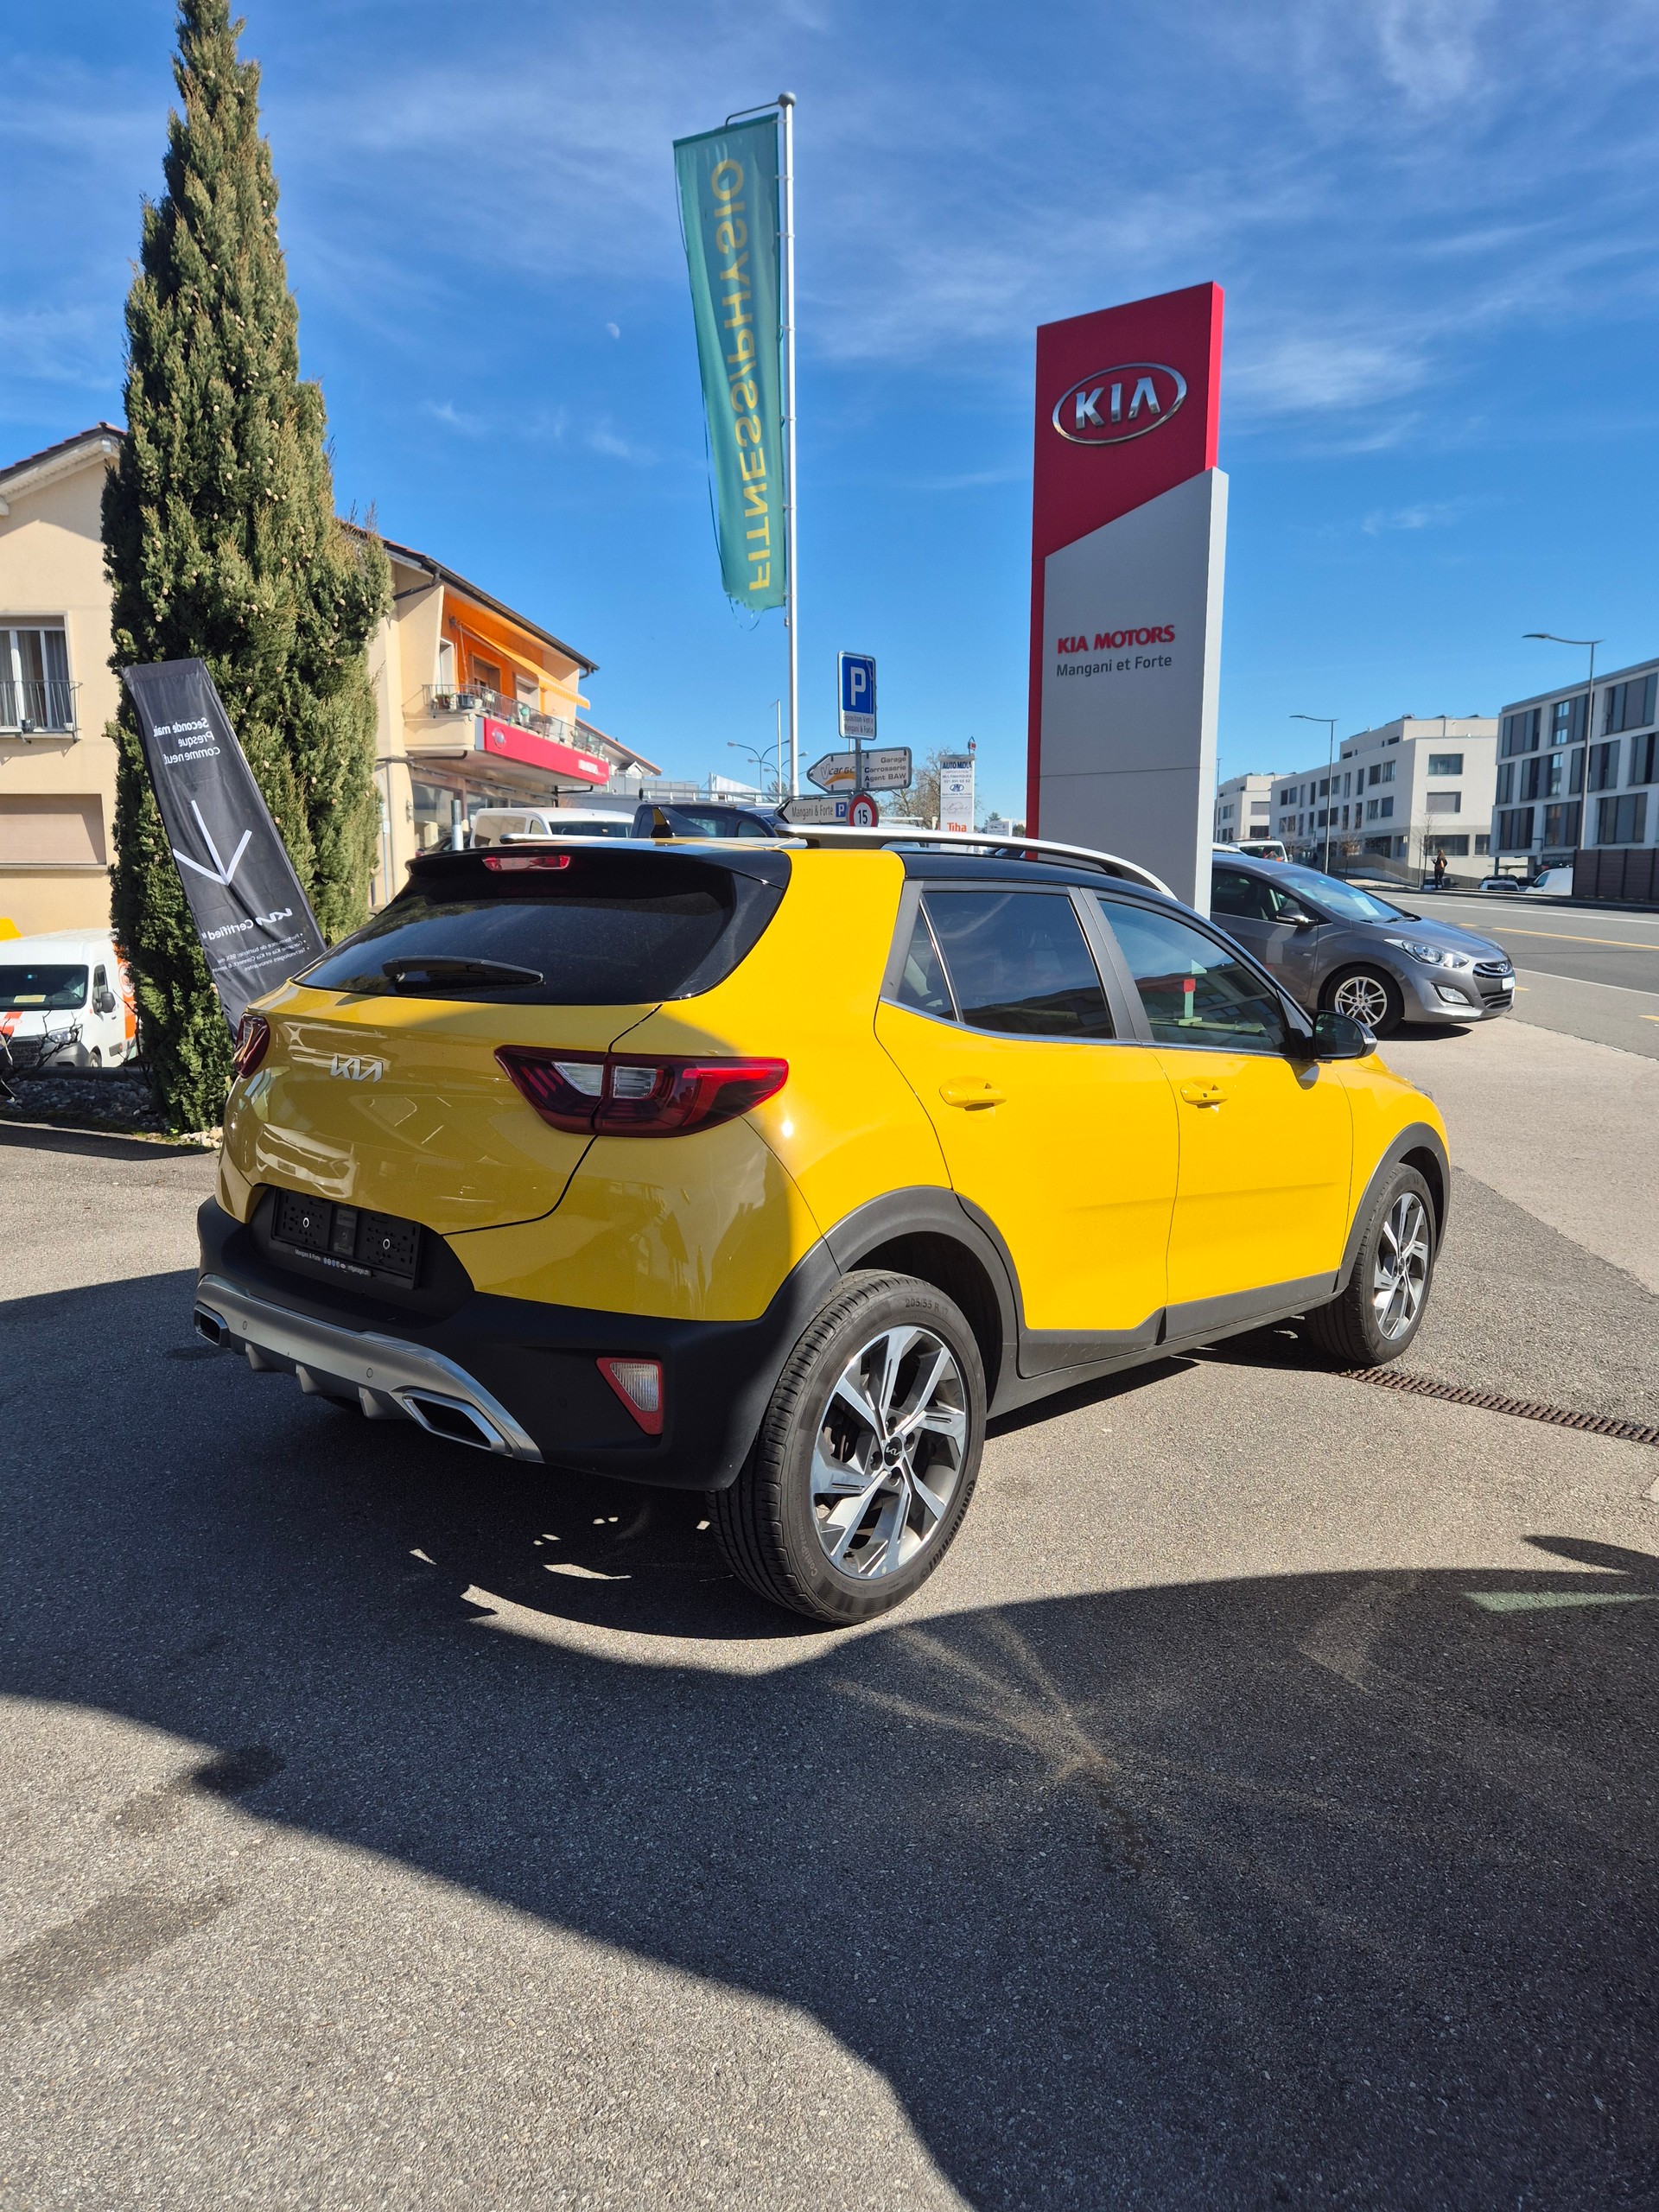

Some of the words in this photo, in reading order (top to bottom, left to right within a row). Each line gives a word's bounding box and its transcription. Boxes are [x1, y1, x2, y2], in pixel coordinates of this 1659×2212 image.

[1076, 377, 1160, 430] KIA
[1058, 635, 1089, 654] KIA
[1094, 625, 1176, 651] MOTORS
[1057, 658, 1113, 677] Mangani
[1116, 658, 1131, 671] et
[1135, 655, 1173, 670] Forte
[850, 666, 867, 706] P
[864, 765, 906, 773] Carrosserie
[791, 805, 814, 820] Mangani
[814, 805, 818, 817] &
[819, 804, 833, 817] Forte
[858, 810, 868, 825] 15
[329, 1054, 384, 1083] KIA
